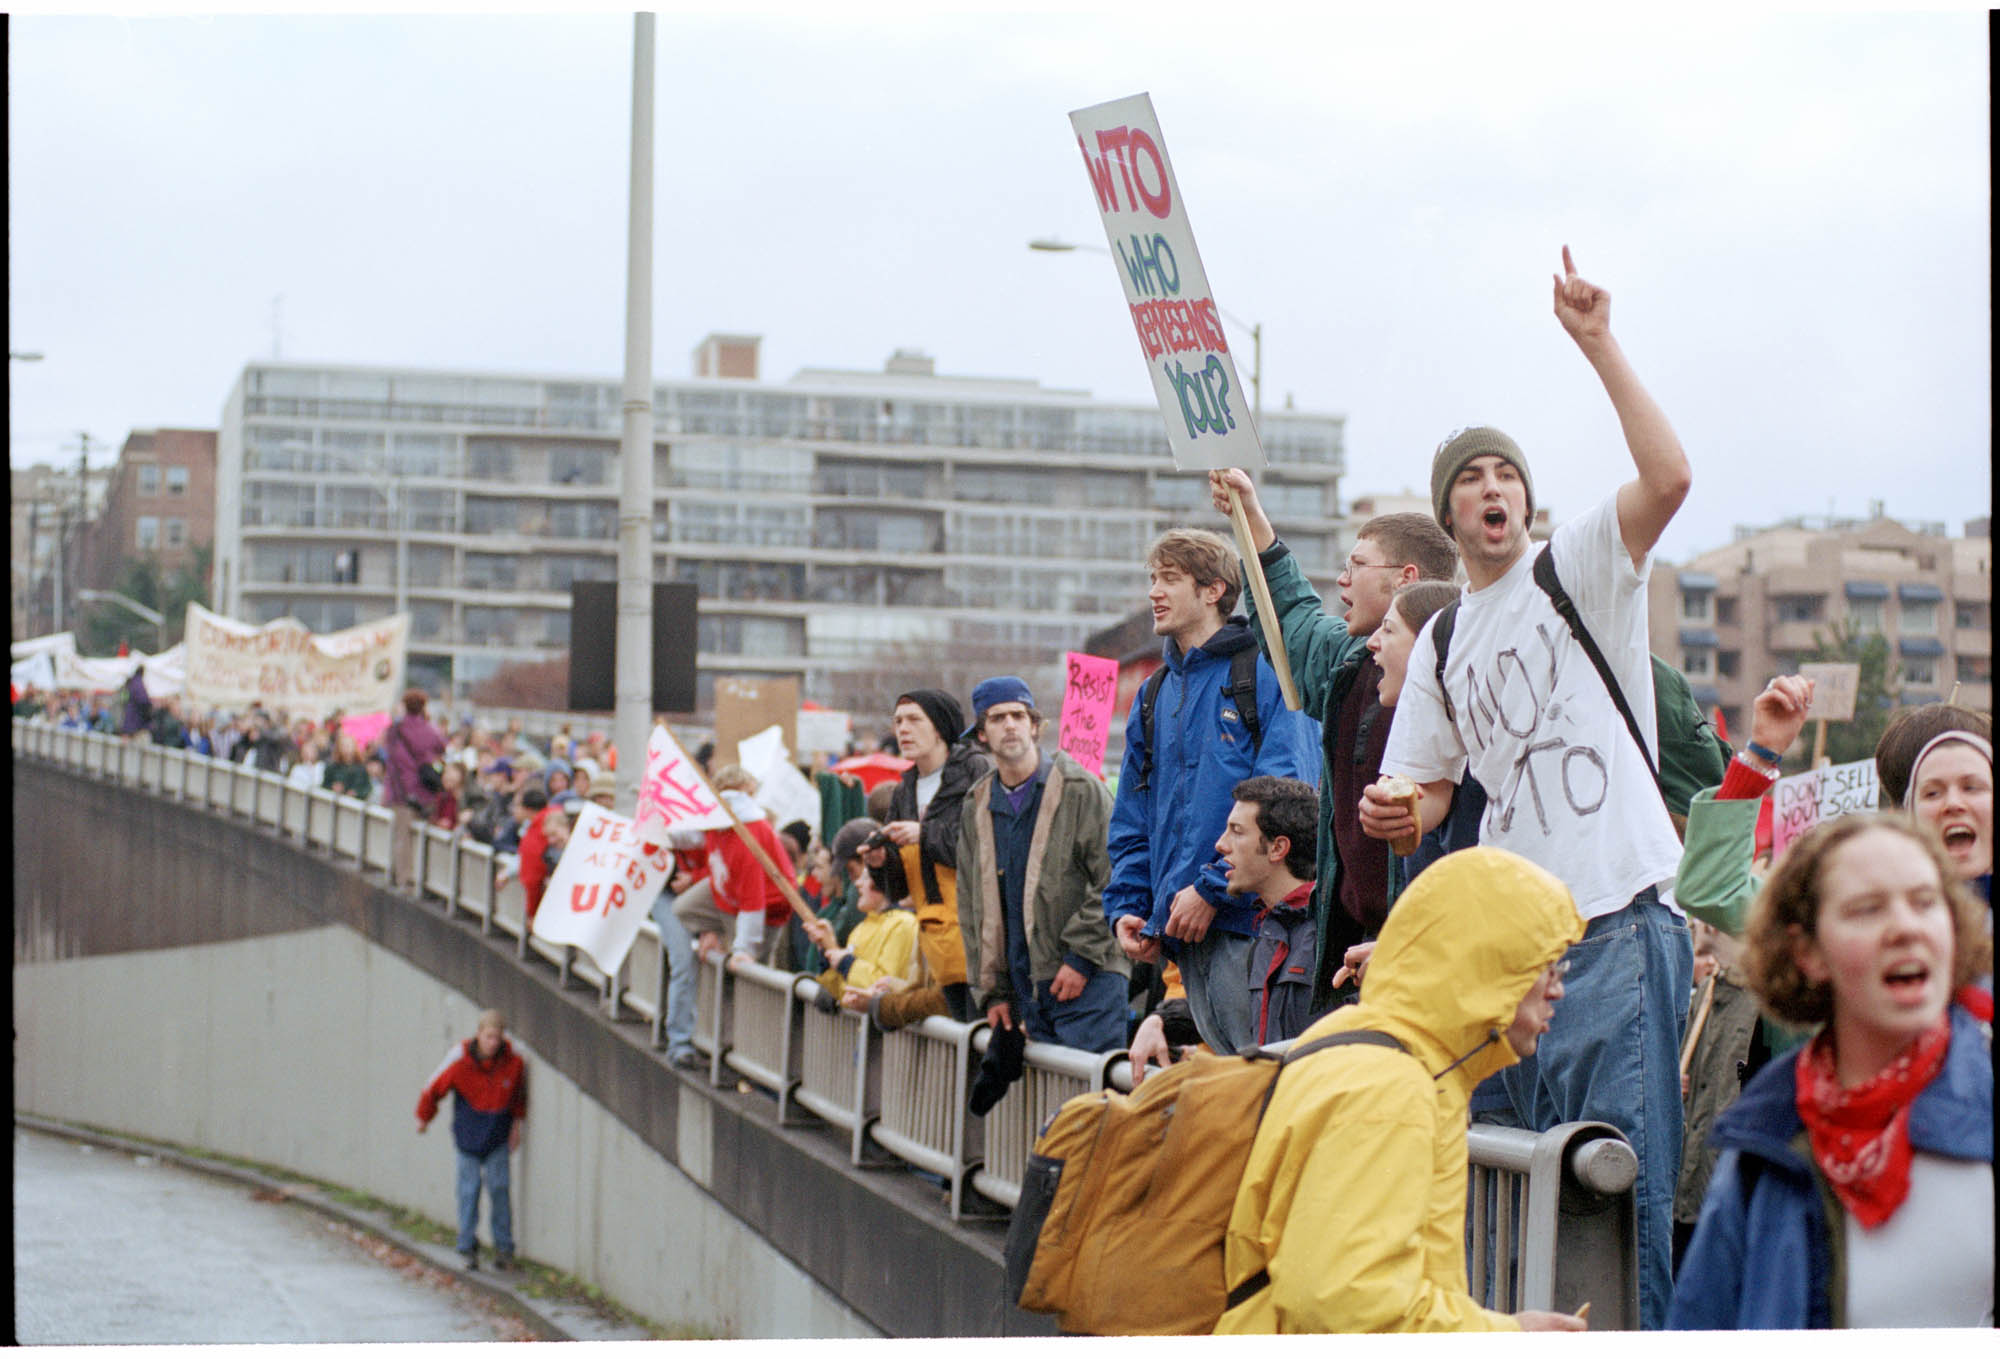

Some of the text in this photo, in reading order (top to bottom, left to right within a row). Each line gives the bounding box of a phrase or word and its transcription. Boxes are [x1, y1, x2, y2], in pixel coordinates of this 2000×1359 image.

[1078, 125, 1171, 219] WTO
[1117, 233, 1180, 297] WHO
[1129, 298, 1229, 362] REPRESENTS
[1164, 354, 1236, 439] YOU?
[1069, 659, 1114, 704] Resist
[1070, 706, 1096, 731] The
[1835, 763, 1873, 795] SELL
[1825, 789, 1877, 817] SOUL
[571, 883, 626, 918] UP
